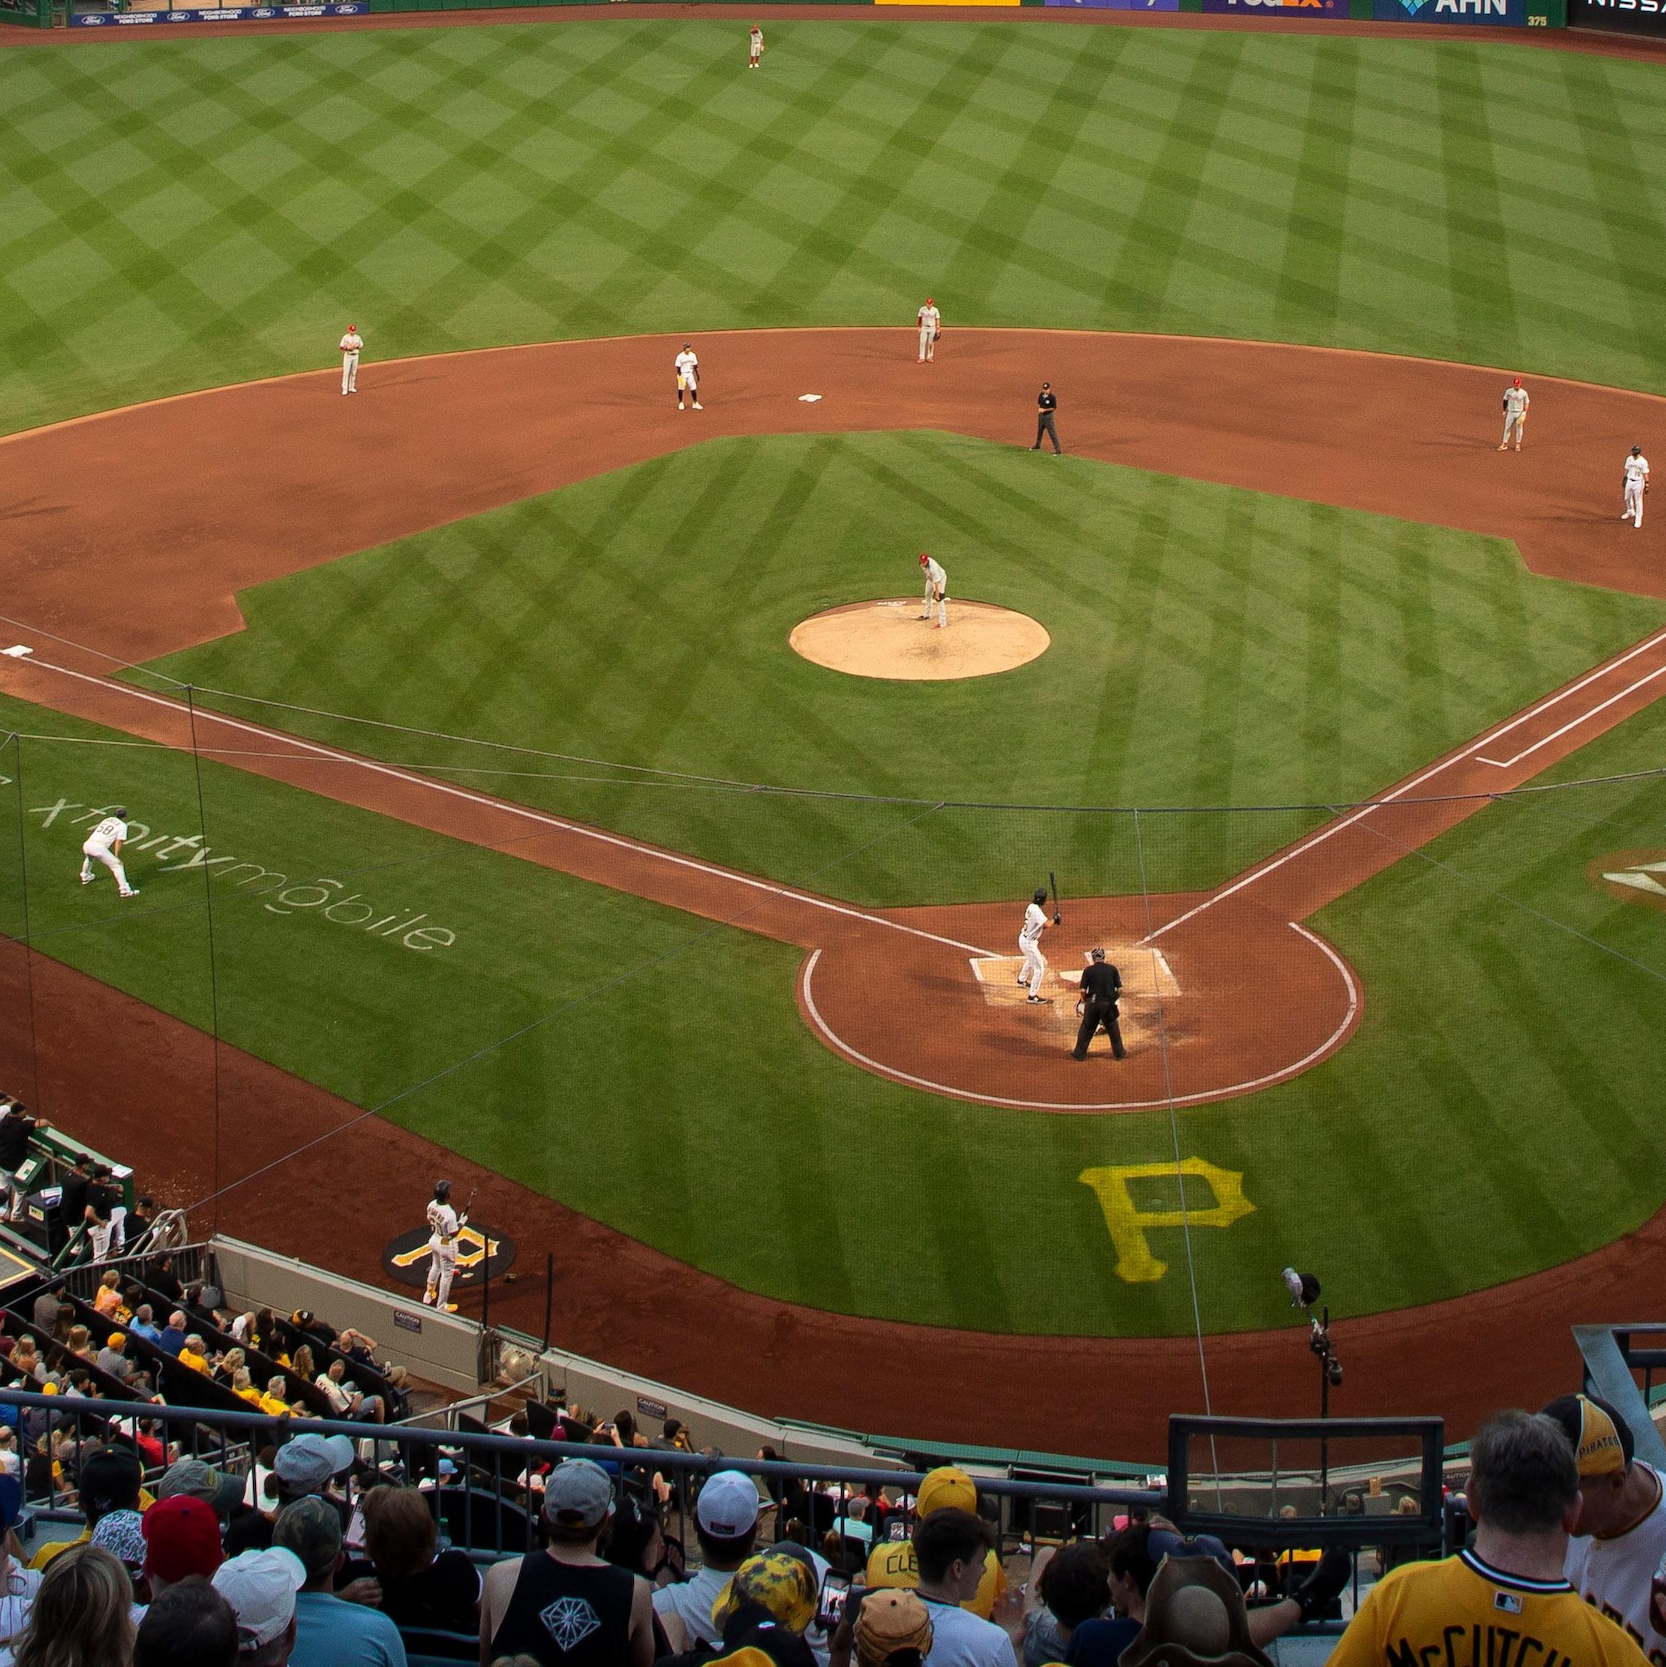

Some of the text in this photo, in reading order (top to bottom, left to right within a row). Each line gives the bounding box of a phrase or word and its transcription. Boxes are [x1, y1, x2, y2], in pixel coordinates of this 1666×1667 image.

[1527, 16, 1547, 27] 375
[395, 1311, 420, 1325] CAUTION
[638, 1396, 665, 1411] CAUTION
